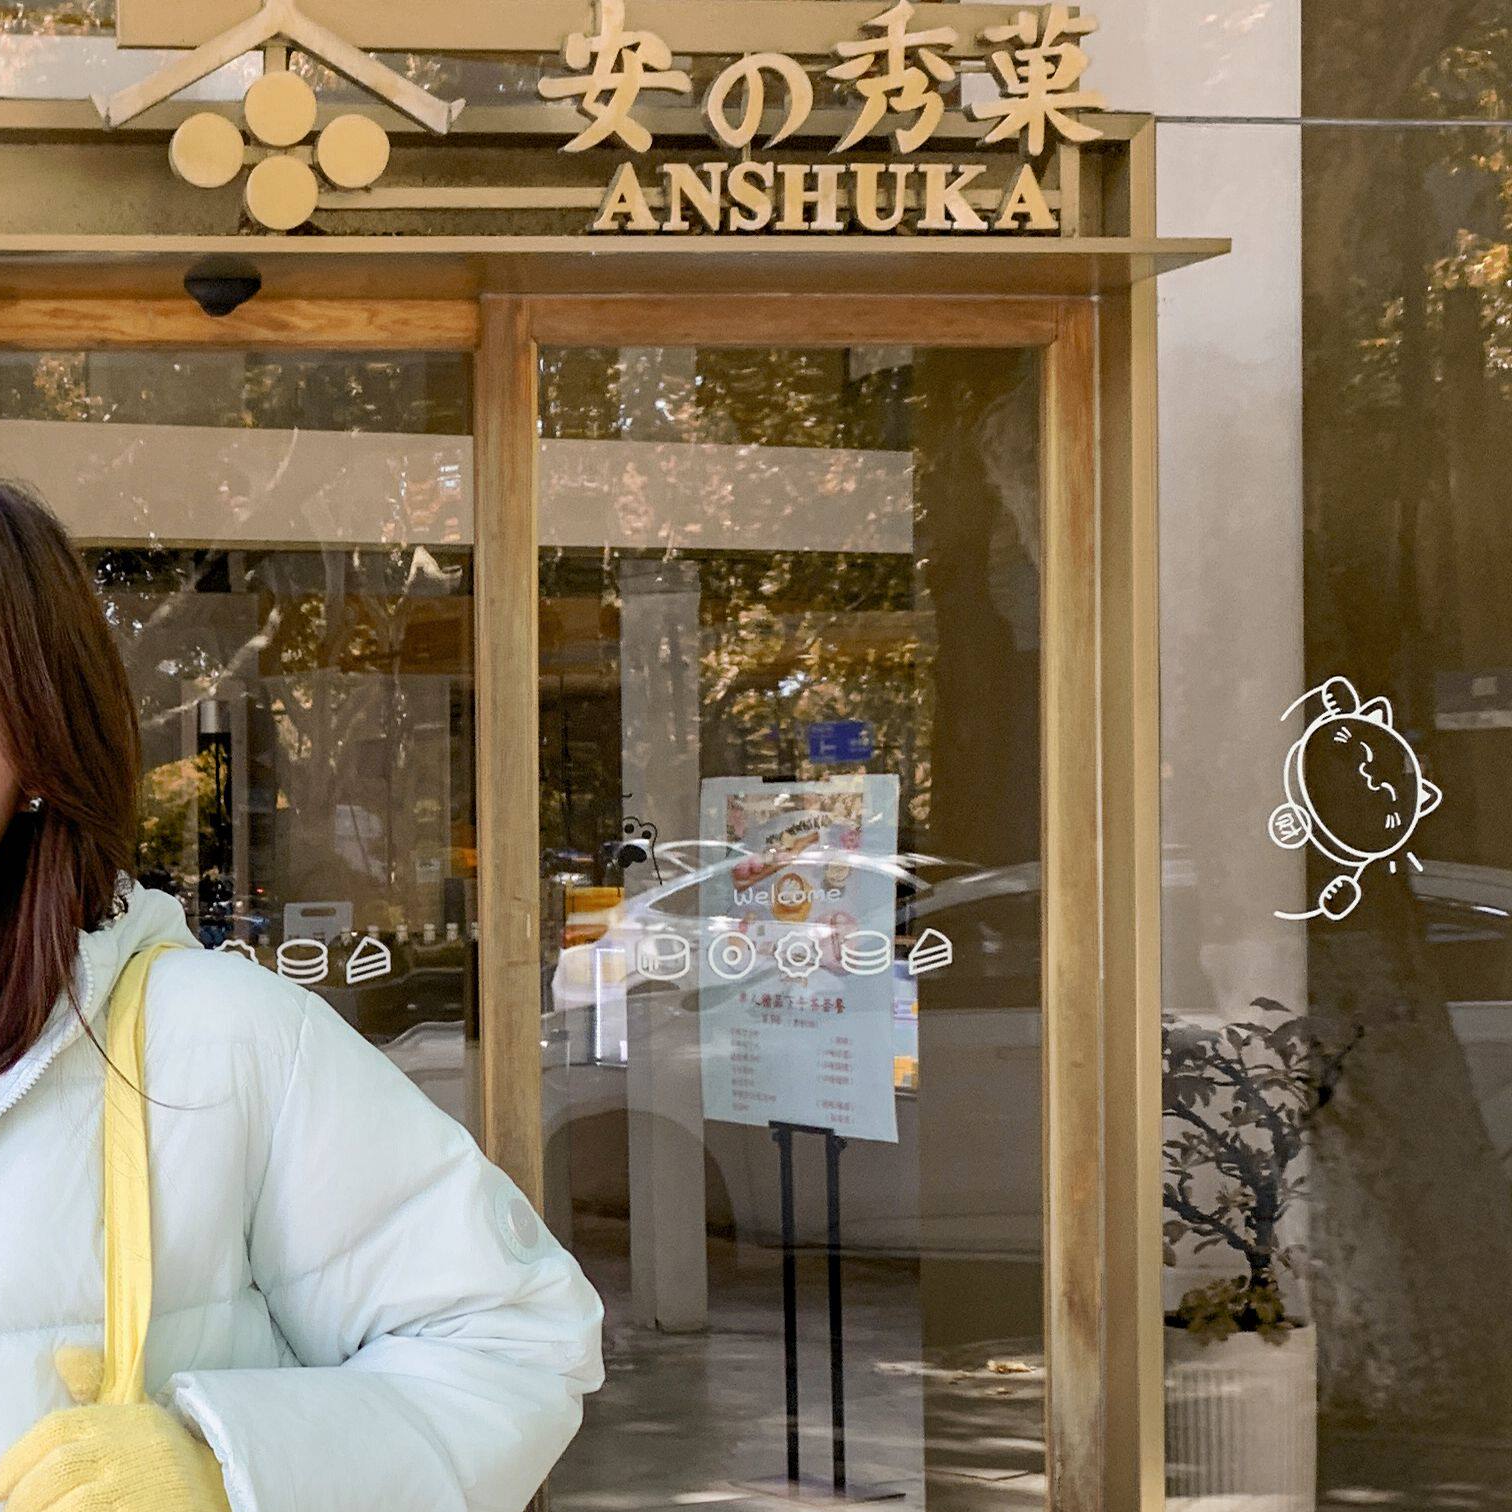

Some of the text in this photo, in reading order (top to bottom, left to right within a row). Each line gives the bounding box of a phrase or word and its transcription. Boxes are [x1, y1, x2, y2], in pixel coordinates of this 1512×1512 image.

[537, 0, 1107, 156] 安の秀菓
[591, 161, 1061, 233] ANSHUKA
